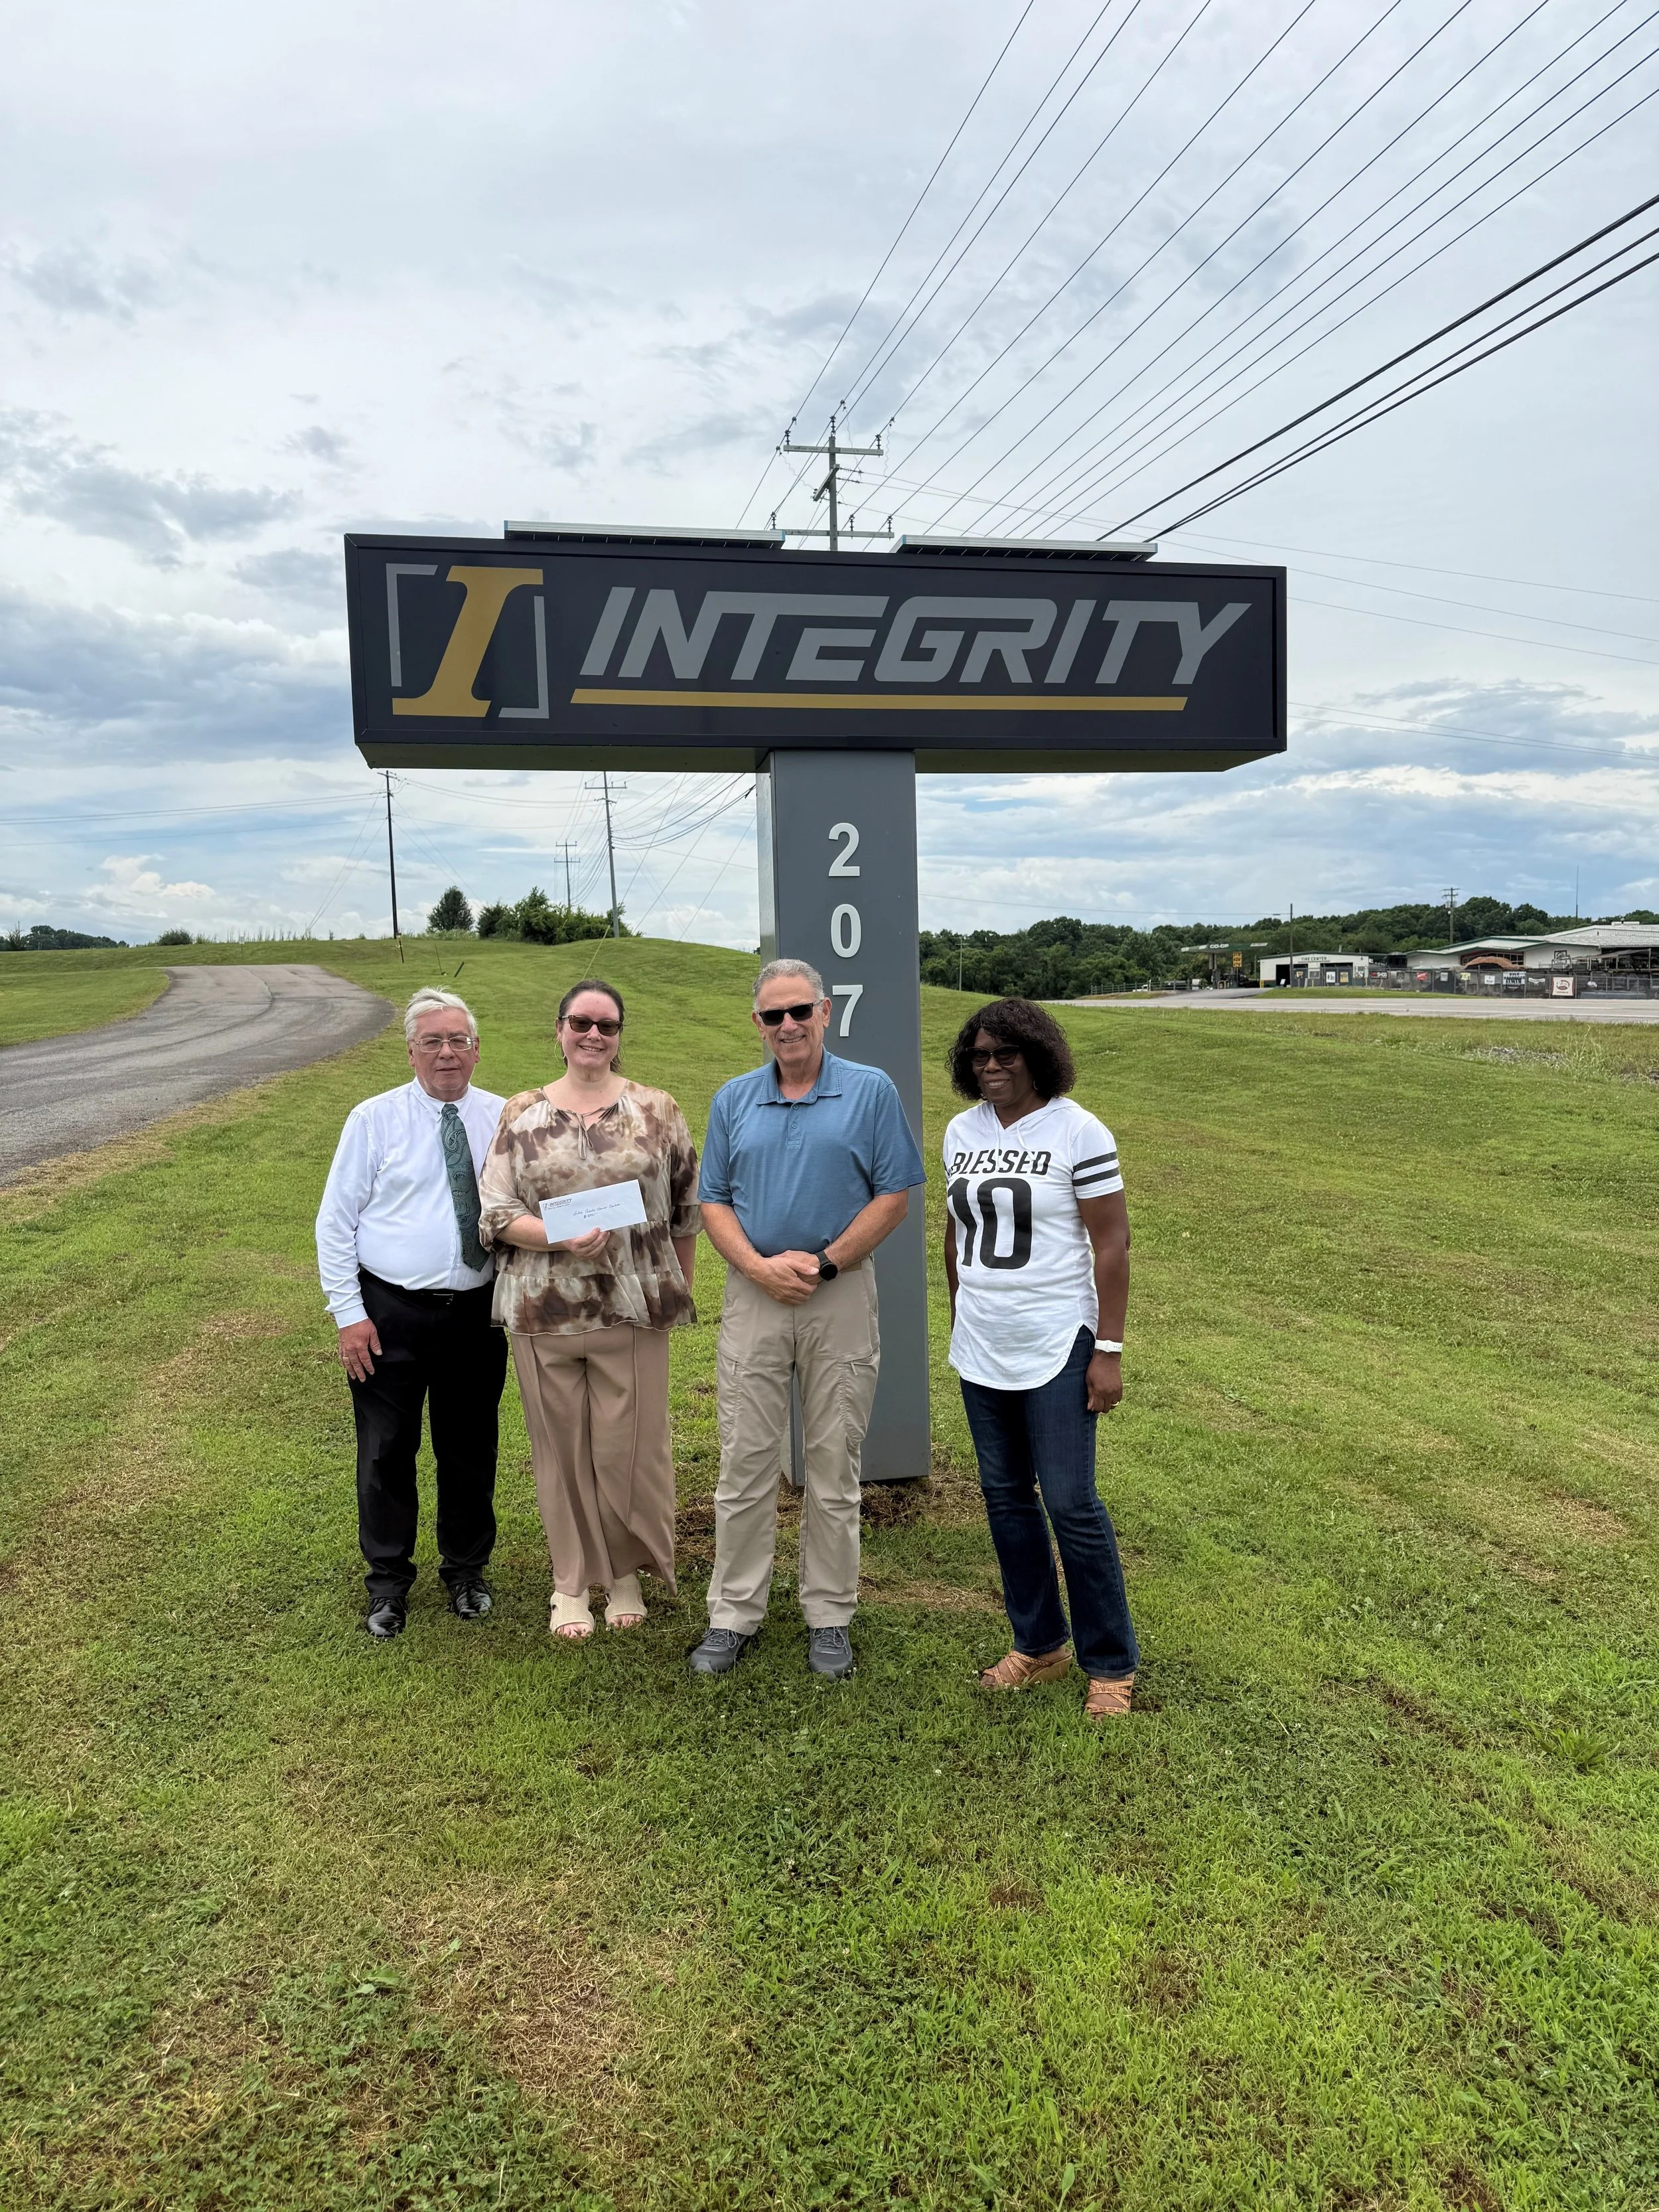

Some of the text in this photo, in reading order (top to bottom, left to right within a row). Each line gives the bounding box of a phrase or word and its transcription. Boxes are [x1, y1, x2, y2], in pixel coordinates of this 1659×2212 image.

[392, 565, 543, 717] I
[579, 587, 1253, 685] INTEGRITY
[828, 822, 863, 1037] 207
[549, 1198, 572, 1207] INTEGRITY
[950, 1149, 1052, 1175] BLESSED
[948, 1177, 1033, 1270] 10
